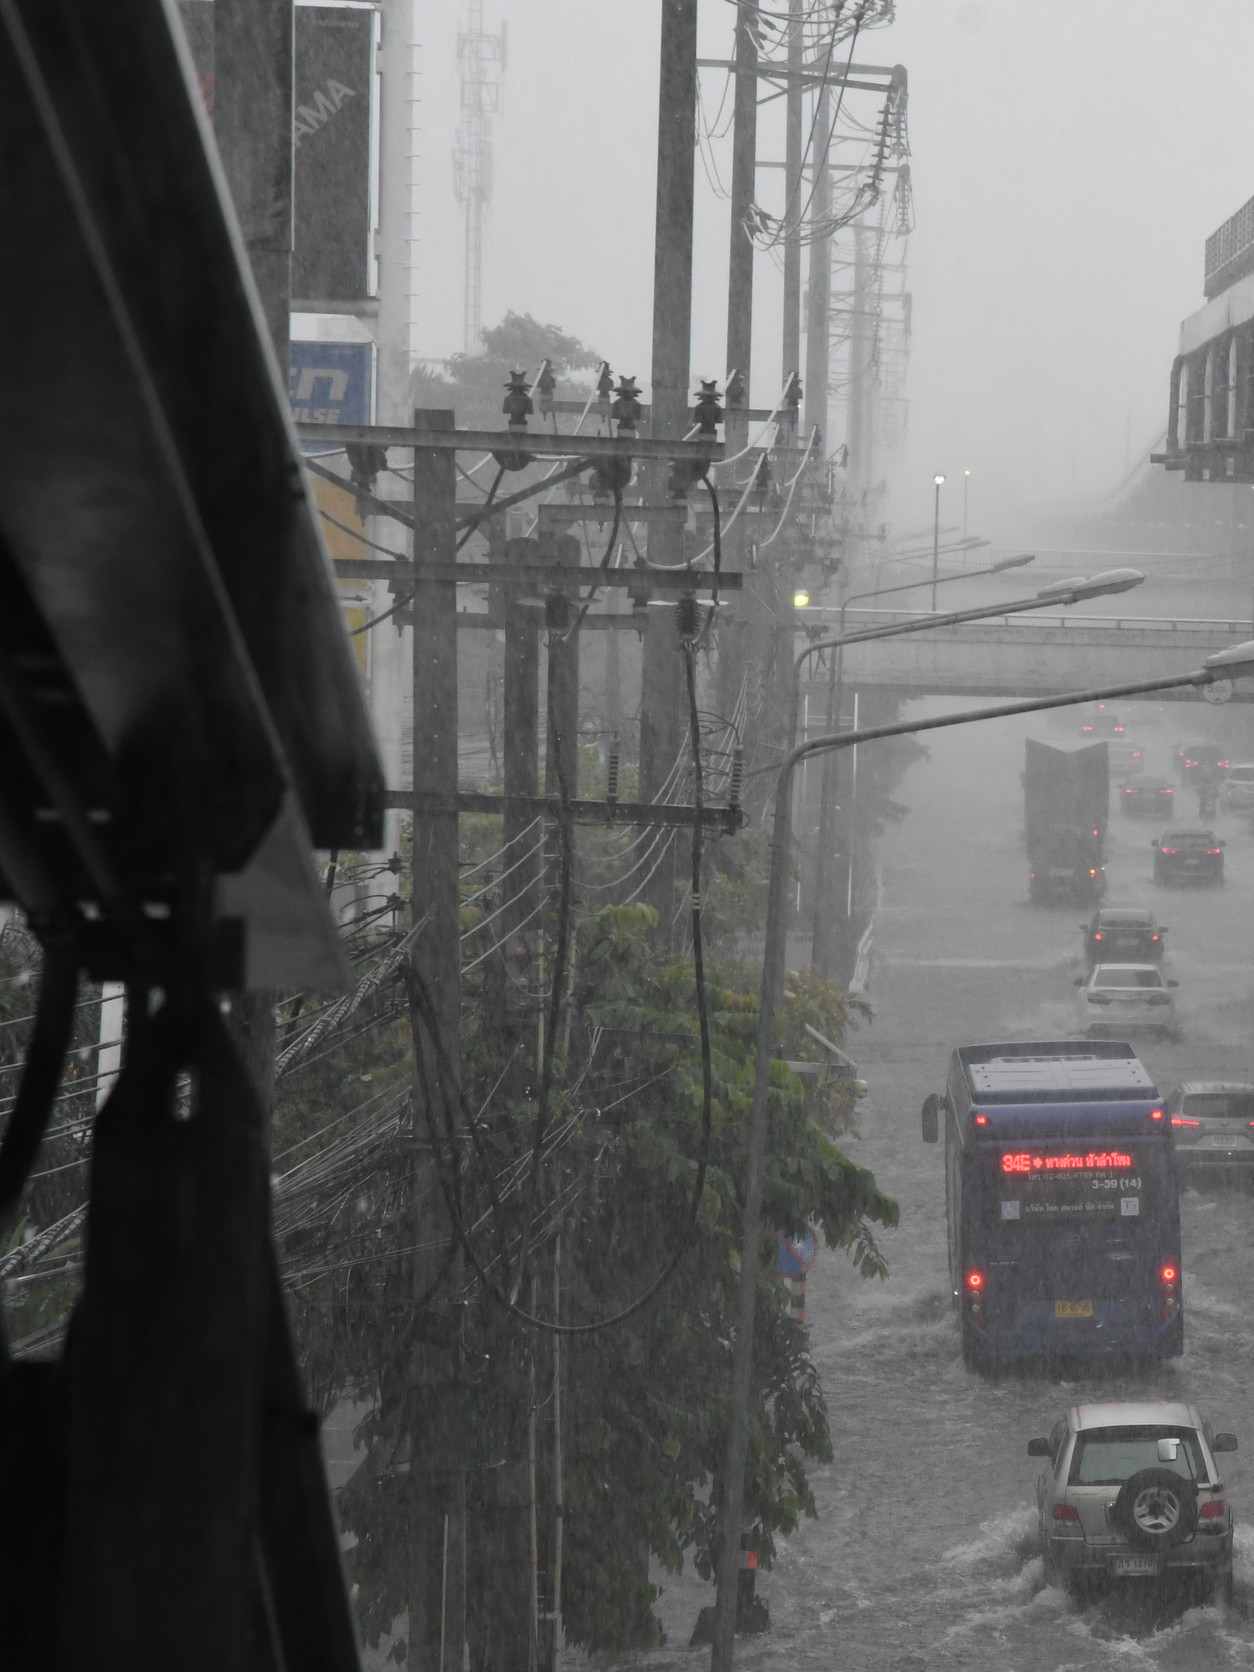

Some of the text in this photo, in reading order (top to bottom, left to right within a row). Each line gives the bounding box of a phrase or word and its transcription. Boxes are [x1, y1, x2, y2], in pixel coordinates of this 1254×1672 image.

[1002, 1154, 1031, 1172] 34E
[1045, 1153, 1083, 1169] ทางด่วน
[1092, 1177, 1142, 1190] 3-39 (14)
